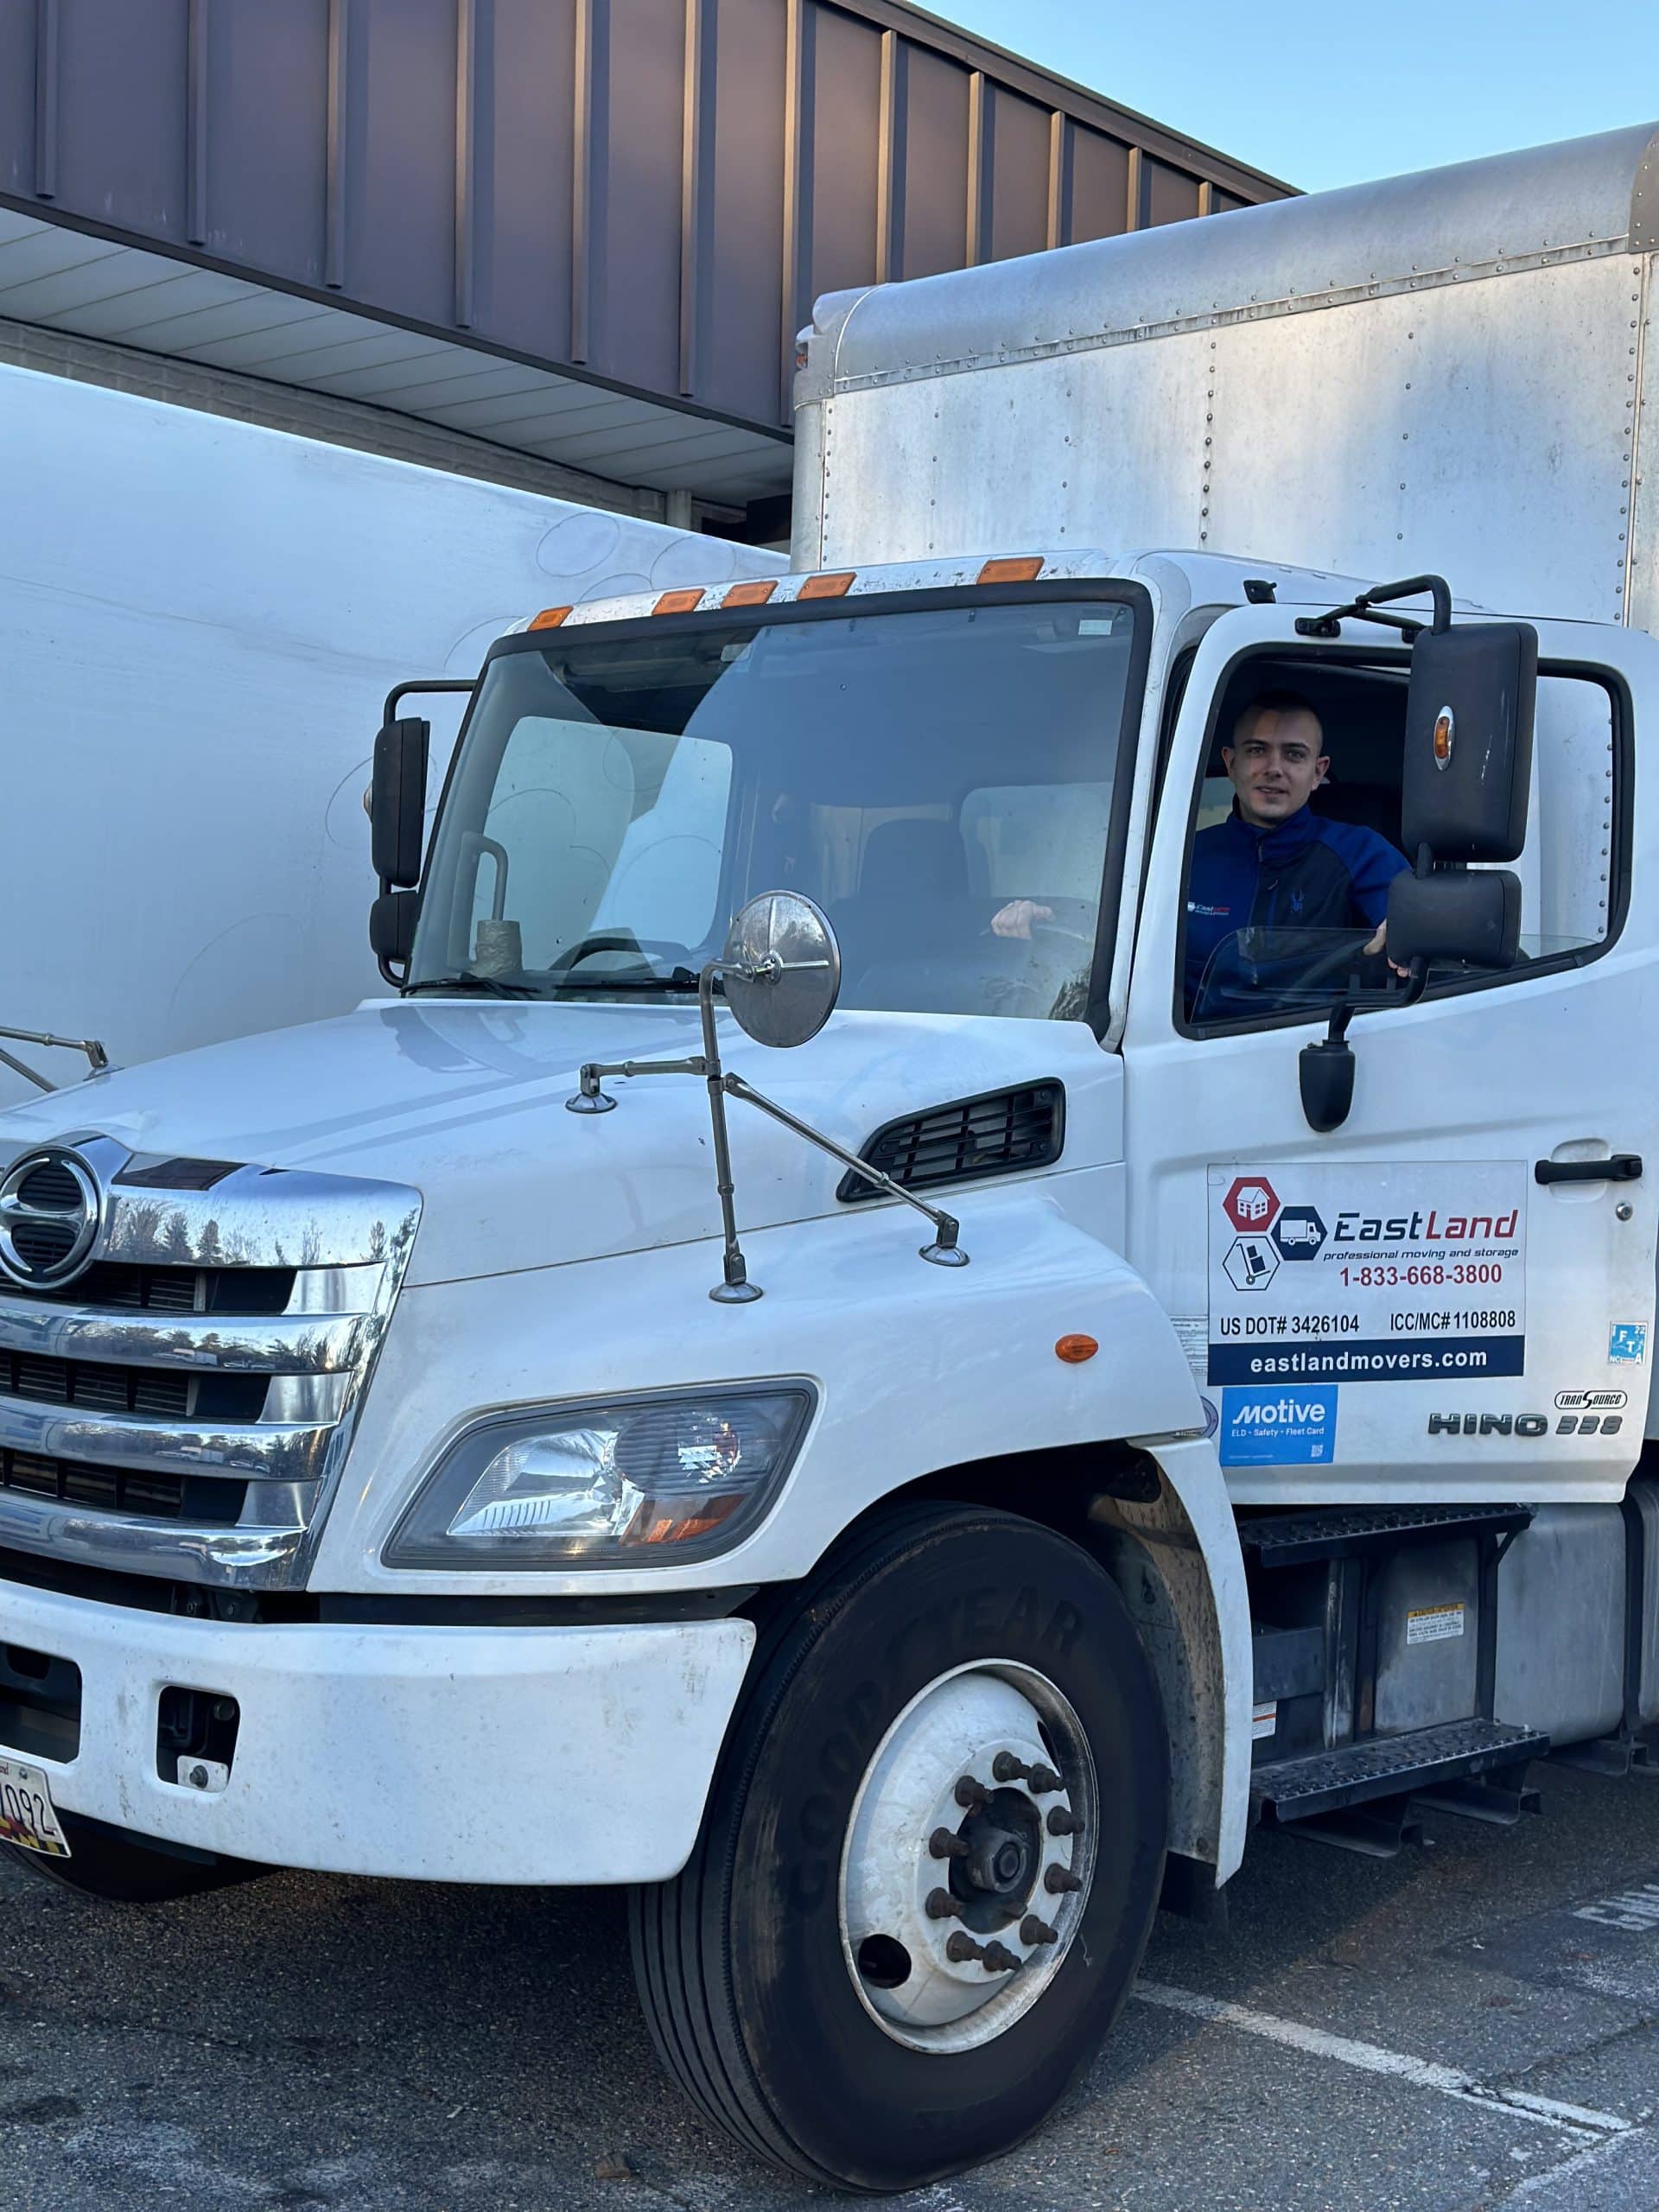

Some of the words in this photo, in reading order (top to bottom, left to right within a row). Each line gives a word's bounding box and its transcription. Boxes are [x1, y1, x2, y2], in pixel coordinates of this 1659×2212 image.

[1333, 1210, 1519, 1242] EastLand
[1323, 1249, 1399, 1262] professional
[1401, 1249, 1446, 1260] moving
[1448, 1248, 1471, 1258] and
[1473, 1248, 1519, 1259] storage
[1339, 1263, 1502, 1287] 1-833-668-3800
[1220, 1318, 1241, 1335] US
[1245, 1316, 1287, 1335] DOT#
[1291, 1314, 1359, 1333] 3426104
[1389, 1313, 1451, 1332] ICC/MC#
[1454, 1311, 1516, 1330] 1108808
[1250, 1351, 1487, 1374] eastlandmovers.com
[1254, 1428, 1278, 1438] Safety
[1428, 1413, 1548, 1437] HINO
[1555, 1415, 1623, 1435] 338
[0, 1783, 55, 1836] 092
